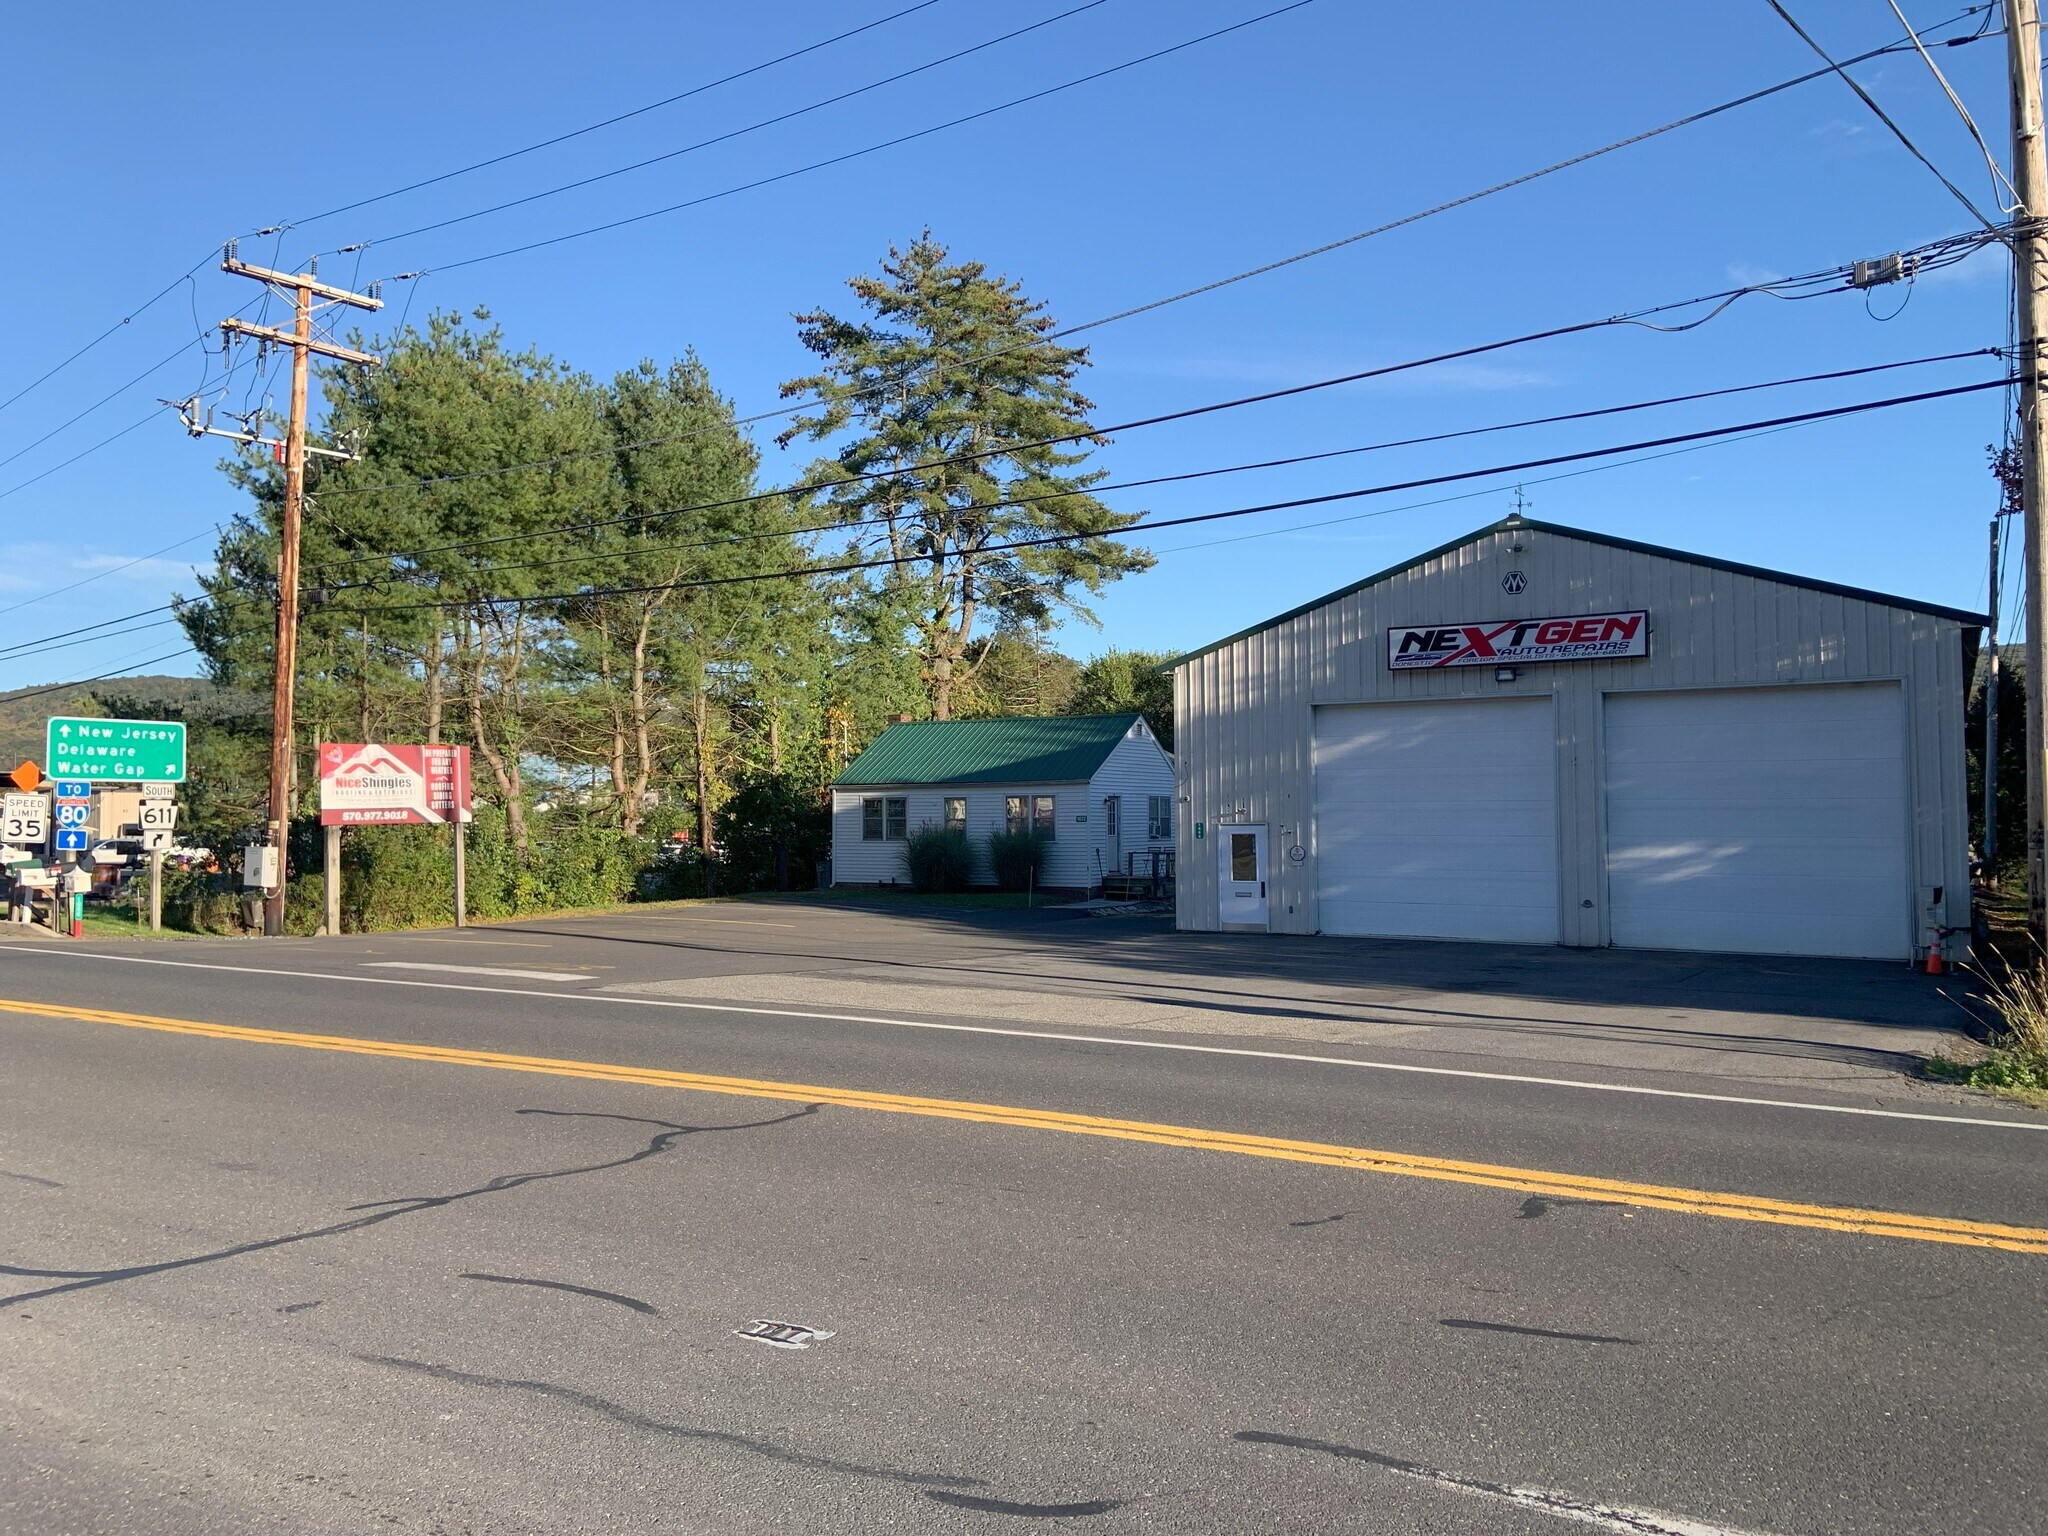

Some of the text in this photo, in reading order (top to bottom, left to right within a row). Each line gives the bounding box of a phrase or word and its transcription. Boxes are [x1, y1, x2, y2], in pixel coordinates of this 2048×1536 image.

[1397, 616, 1642, 661] NEXTGEN
[1500, 641, 1631, 655] AUTO REPAIRS
[1457, 656, 1495, 664] FOREIGN
[1497, 653, 1556, 662] SPECIALISTS
[78, 725, 177, 743] New Jersey
[58, 742, 136, 757] Delaware
[57, 761, 145, 777] Water Gap
[335, 776, 412, 789] NiceShingles
[430, 782, 454, 791] ROOFING
[66, 784, 82, 795] TO
[145, 785, 173, 796] SOUTH
[9, 799, 44, 808] SPEED
[431, 801, 455, 810] GUTTERS
[11, 809, 39, 817] LIMIT
[60, 806, 87, 823] 80
[144, 808, 172, 824] 611
[342, 810, 408, 821] 570.977.9018
[7, 819, 41, 837] 35
